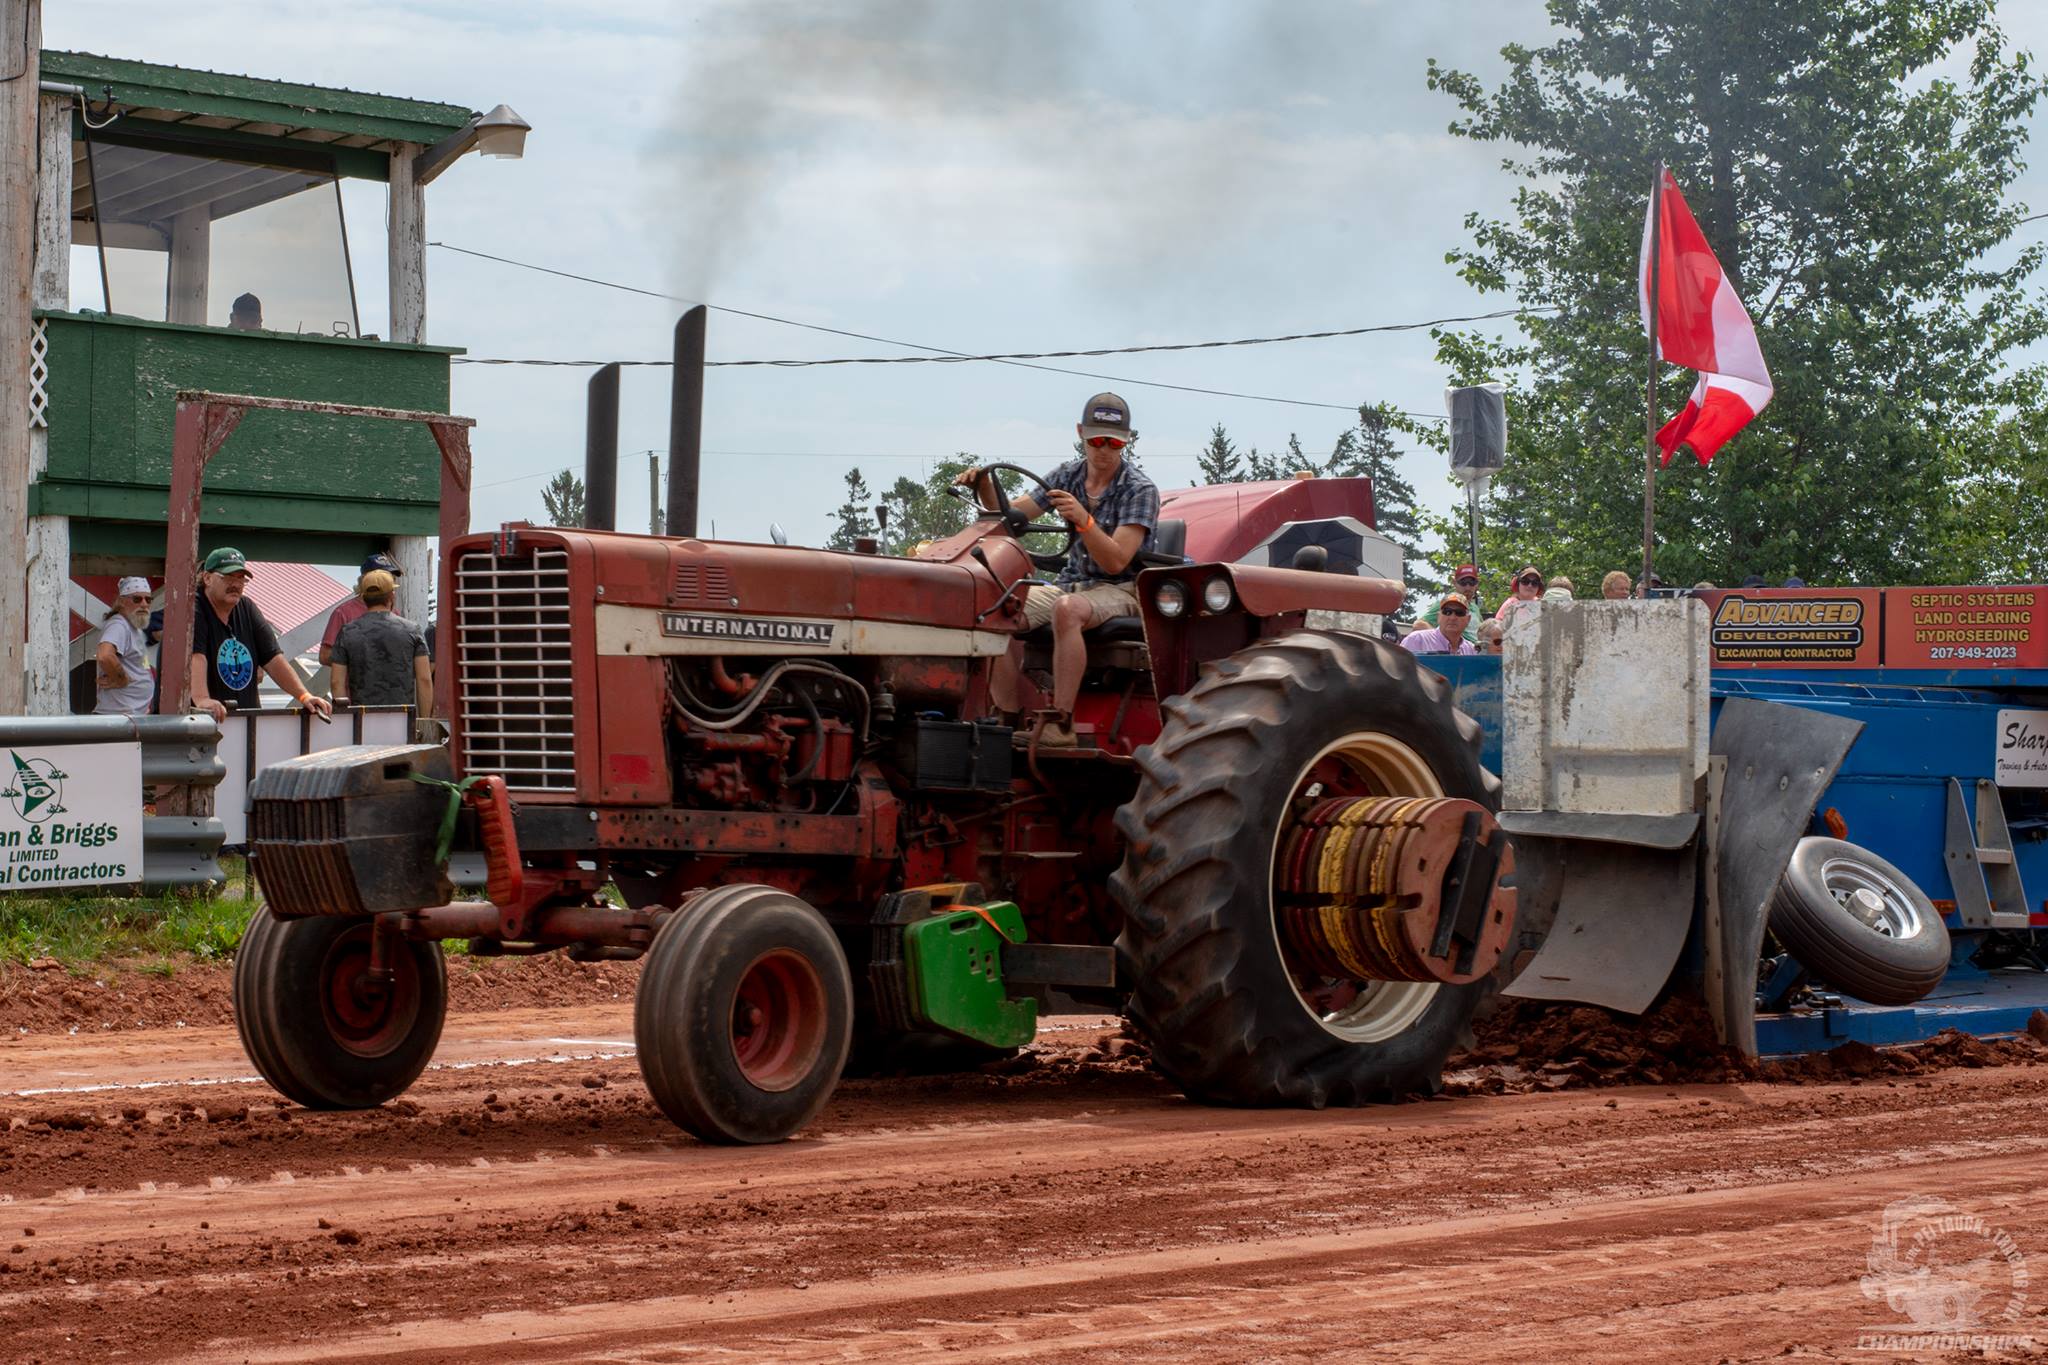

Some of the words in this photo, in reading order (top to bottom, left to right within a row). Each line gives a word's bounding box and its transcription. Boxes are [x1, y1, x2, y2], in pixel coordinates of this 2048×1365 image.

[1911, 594, 1963, 607] SEPTIC
[1967, 593, 2034, 606] SYSTEMS
[1914, 612, 1953, 625] LAND
[1957, 611, 2031, 624] CLEARING
[667, 617, 829, 640] INTERNATIONAL
[1720, 631, 1852, 640] DEVELOPMENT
[1915, 629, 2029, 642] HYDROSEEDING
[1719, 648, 1781, 658] EXCAVATION
[1783, 648, 1853, 658] CONTRACTOR
[1931, 646, 2017, 659] 207-949-2023
[1997, 758, 2022, 774] Towing
[27, 824, 44, 846] &
[50, 822, 118, 848] Briggs
[9, 848, 59, 863] LIMITED
[17, 862, 126, 883] Contractors
